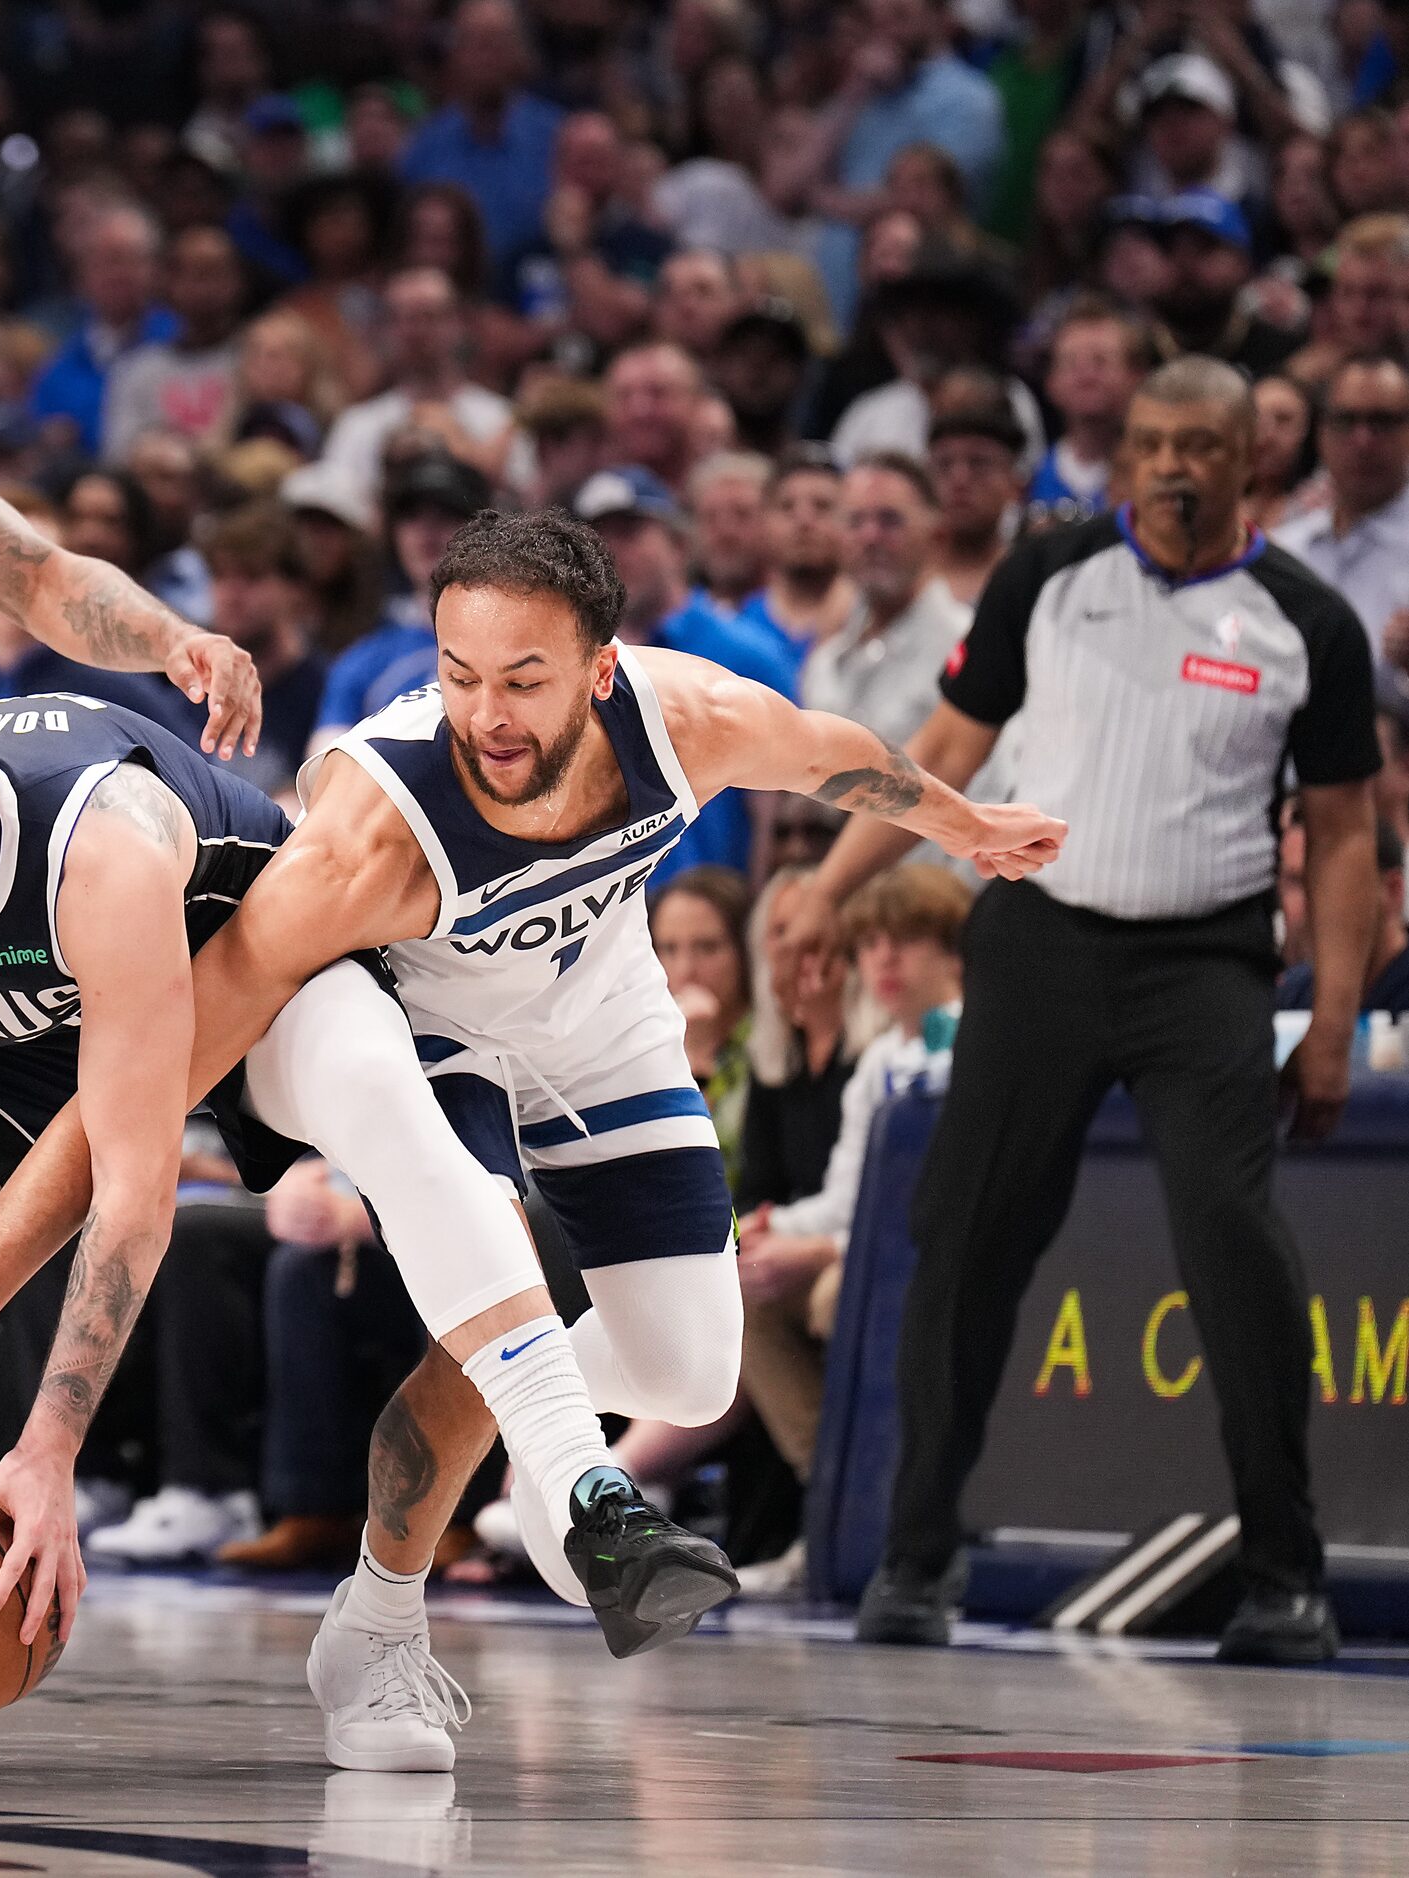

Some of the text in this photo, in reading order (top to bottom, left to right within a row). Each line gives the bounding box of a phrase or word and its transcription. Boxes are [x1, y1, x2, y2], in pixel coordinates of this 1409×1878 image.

[450, 848, 670, 956] WOLVE
[550, 935, 587, 981] 1
[1033, 1288, 1091, 1397] A
